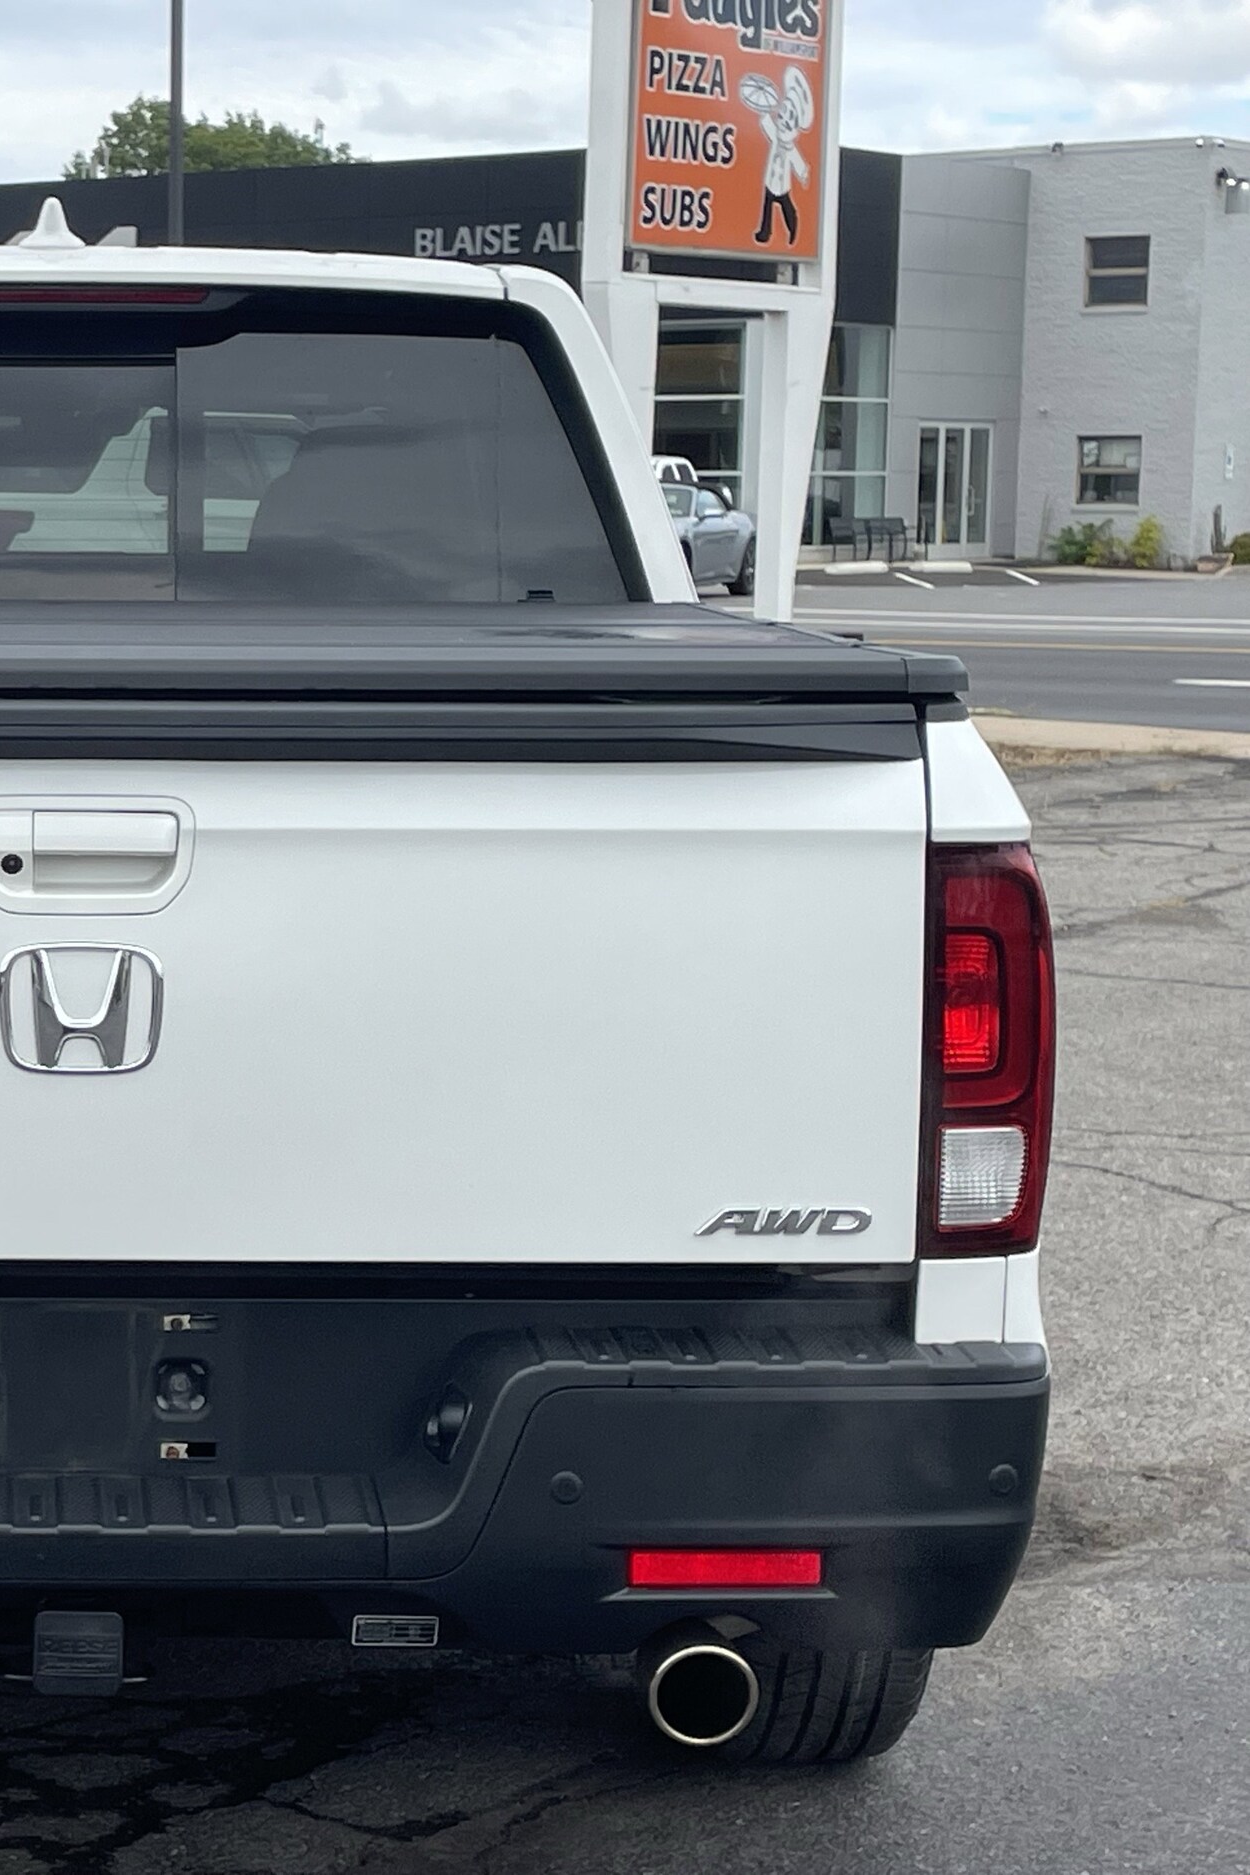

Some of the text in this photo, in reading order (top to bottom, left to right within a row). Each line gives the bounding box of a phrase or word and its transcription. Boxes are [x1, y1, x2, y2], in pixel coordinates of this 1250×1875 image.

[648, 48, 727, 98] PIZZA
[645, 117, 735, 165] WINGS
[642, 185, 711, 230] SUBS
[414, 223, 522, 257] BLAISE
[694, 1205, 873, 1236] AWD
